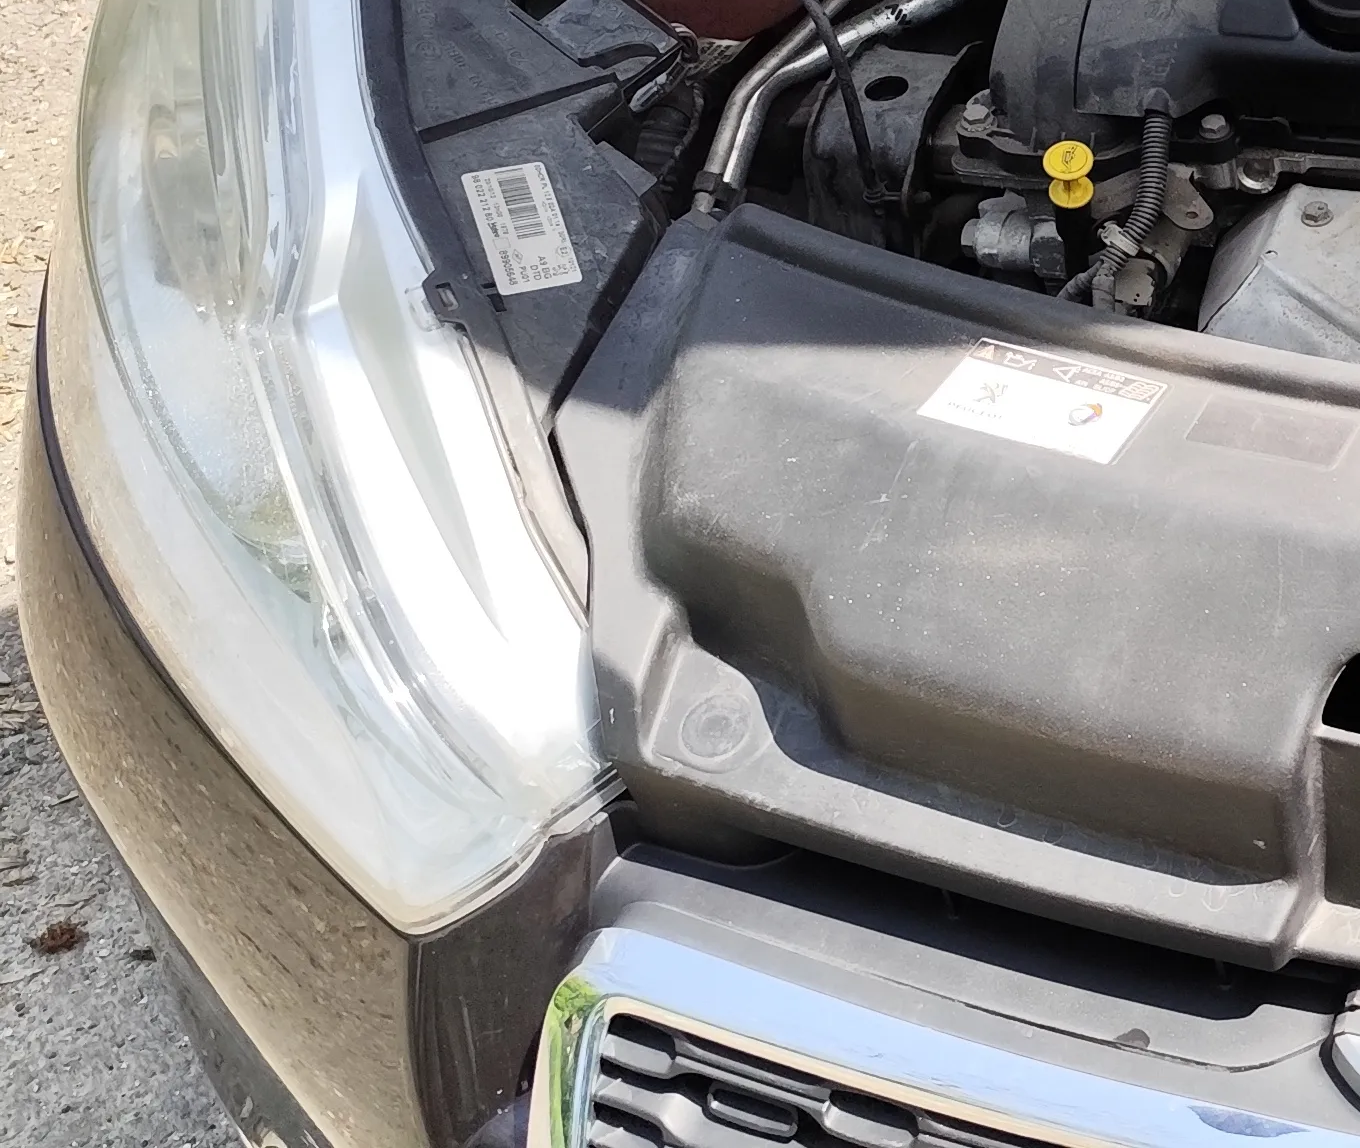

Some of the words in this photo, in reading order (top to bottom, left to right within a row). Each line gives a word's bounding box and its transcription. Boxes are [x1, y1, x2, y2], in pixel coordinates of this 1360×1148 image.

[474, 184, 485, 197] 022
[479, 198, 490, 211] 212
[484, 212, 493, 221] 80
[537, 255, 547, 265] A9
[529, 264, 541, 280] DTD
[541, 267, 552, 279] BG
